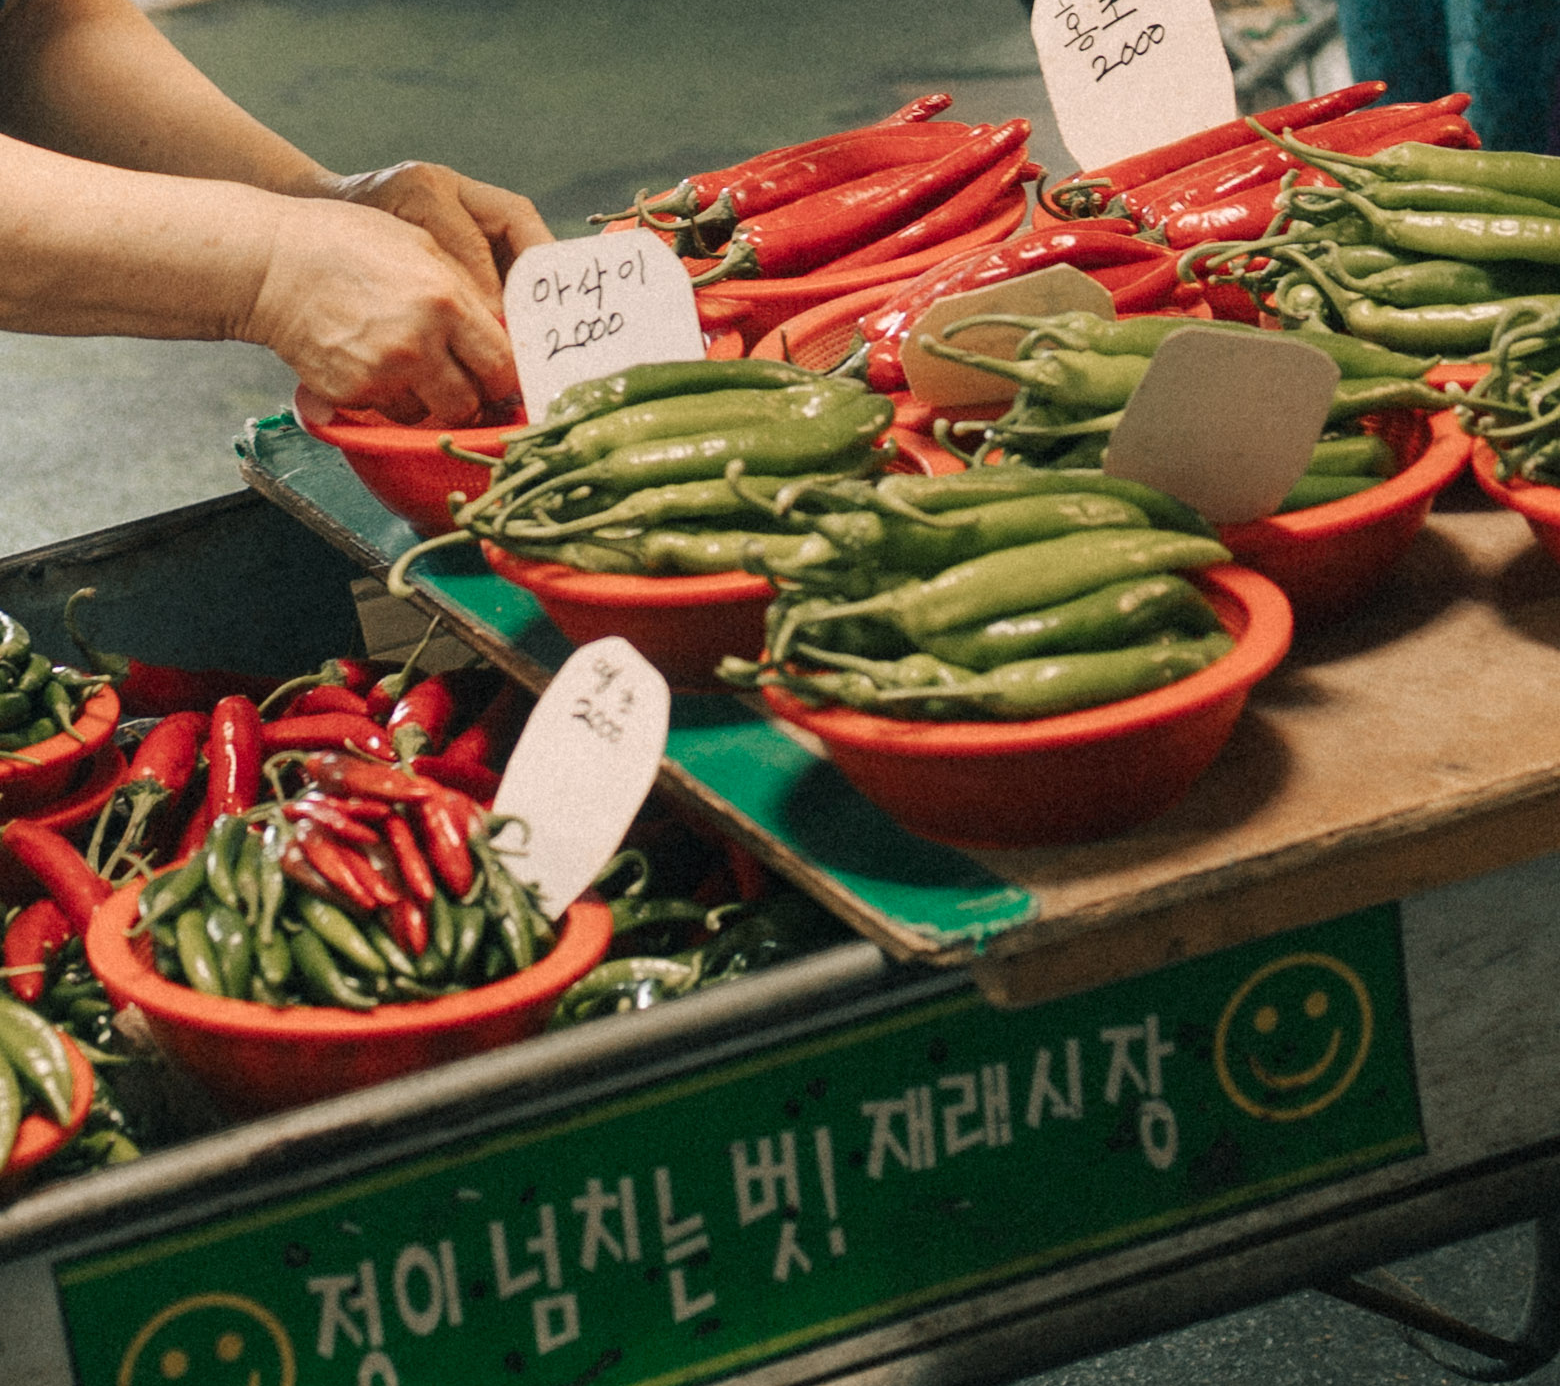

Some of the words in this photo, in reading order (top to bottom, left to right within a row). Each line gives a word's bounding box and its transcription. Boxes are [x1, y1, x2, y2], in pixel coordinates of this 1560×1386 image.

[1091, 23, 1166, 83] 2000
[532, 249, 646, 310] 아삭이
[545, 311, 625, 361] 2000
[489, 1165, 719, 1355] 넘치는
[730, 1126, 849, 1282] 벗!
[862, 1017, 1184, 1180] 재래시장
